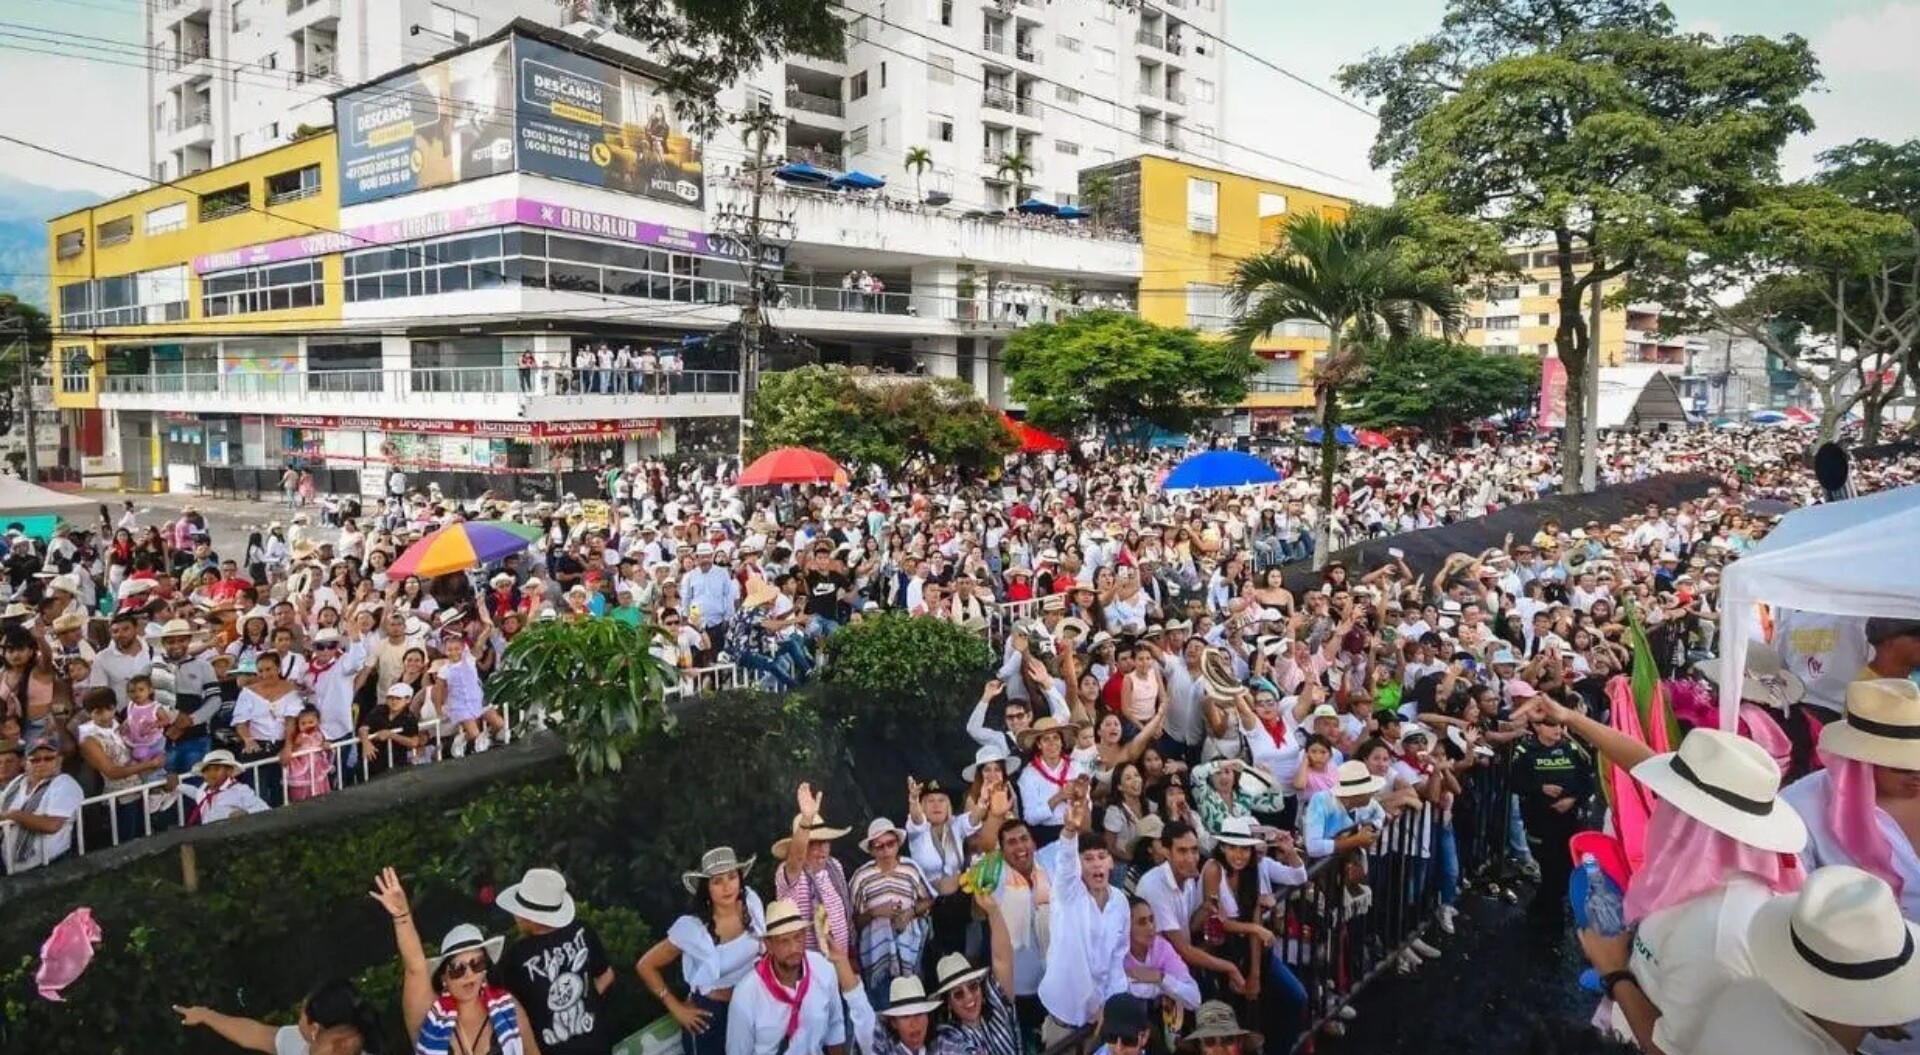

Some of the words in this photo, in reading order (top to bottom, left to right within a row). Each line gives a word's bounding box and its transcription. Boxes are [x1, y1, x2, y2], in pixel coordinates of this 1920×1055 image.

[535, 75, 602, 104] DESCANSO
[358, 102, 412, 132] DESCANSO
[651, 178, 676, 193] HOTEL
[561, 208, 637, 238] OROSALUD
